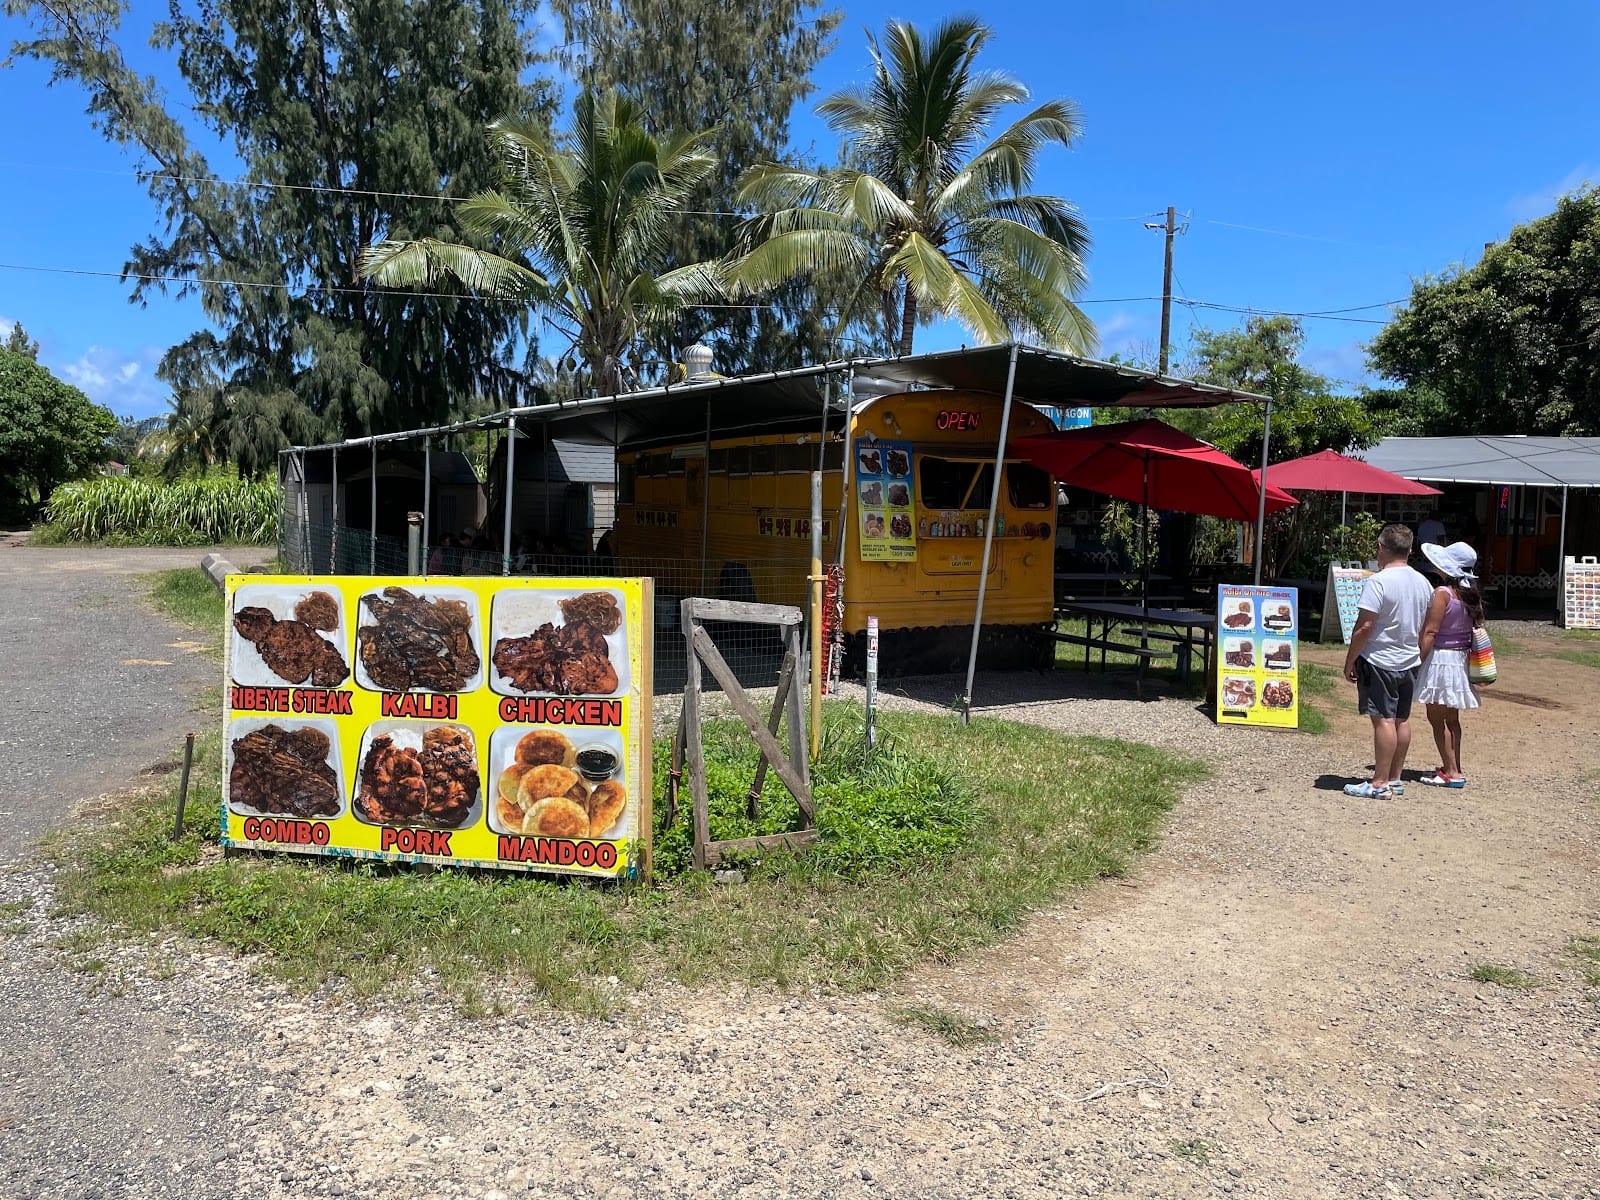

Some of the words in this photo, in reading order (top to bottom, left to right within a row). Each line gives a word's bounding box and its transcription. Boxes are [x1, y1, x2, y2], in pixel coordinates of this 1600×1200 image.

[937, 411, 979, 430] OPEN
[1056, 408, 1089, 418] WAGON
[292, 689, 353, 715] STEAK
[381, 693, 458, 720] KALBI
[498, 697, 622, 727] CHICKEN
[244, 818, 331, 847] COMBO
[380, 828, 453, 857] PORK
[498, 837, 618, 869] MANDOO
